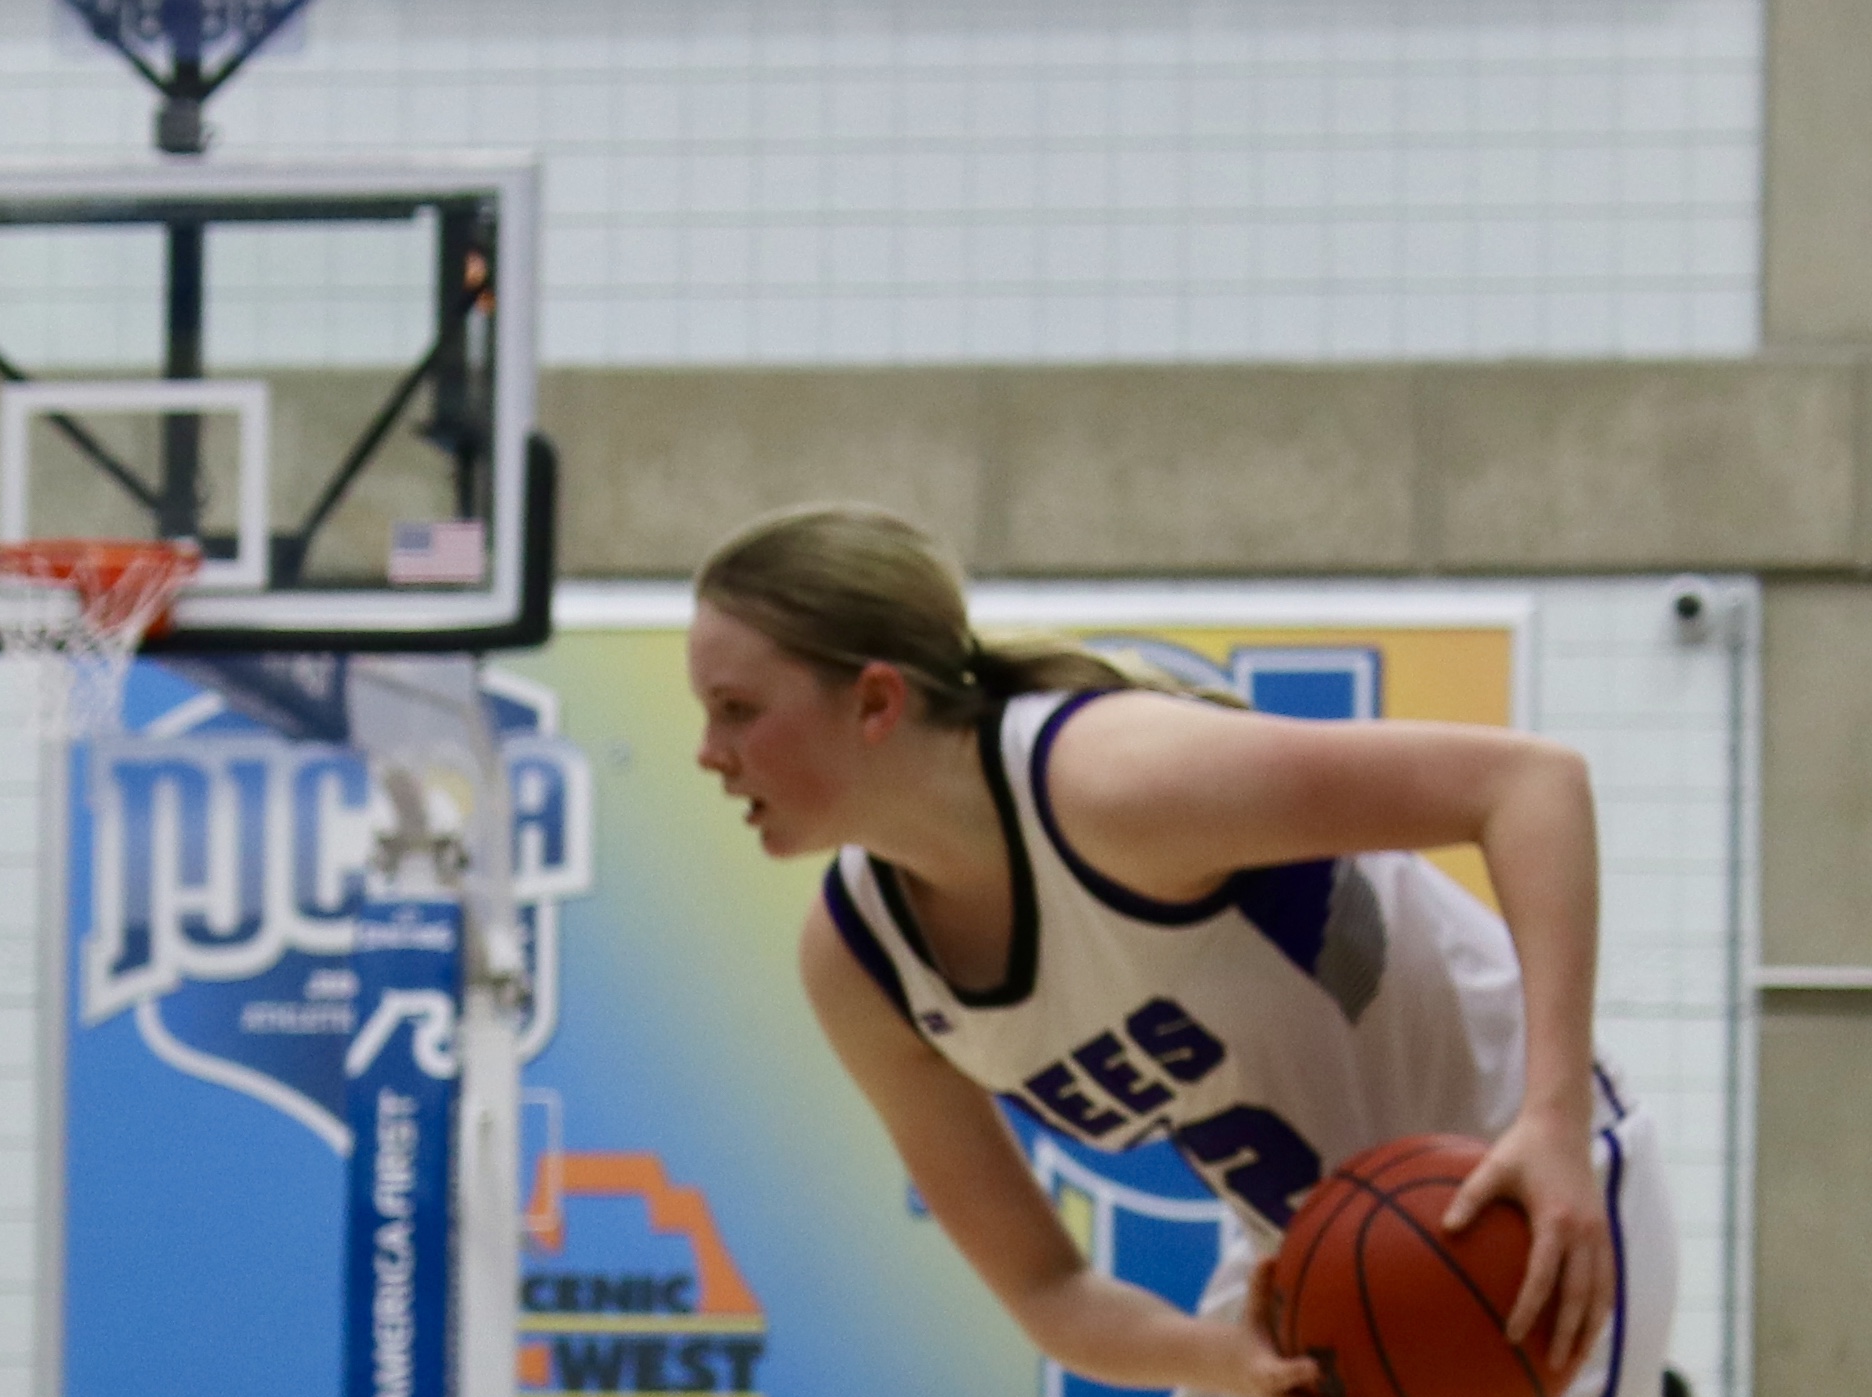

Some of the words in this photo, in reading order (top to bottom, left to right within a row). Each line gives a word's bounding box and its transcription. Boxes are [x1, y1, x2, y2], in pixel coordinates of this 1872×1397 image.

[81, 735, 590, 1028] NJCA
[1010, 996, 1226, 1140] EES
[373, 1086, 419, 1218] FIRST
[1120, 1104, 1322, 1232] 2
[521, 1273, 694, 1314] CENIC
[555, 1336, 764, 1391] WEST
